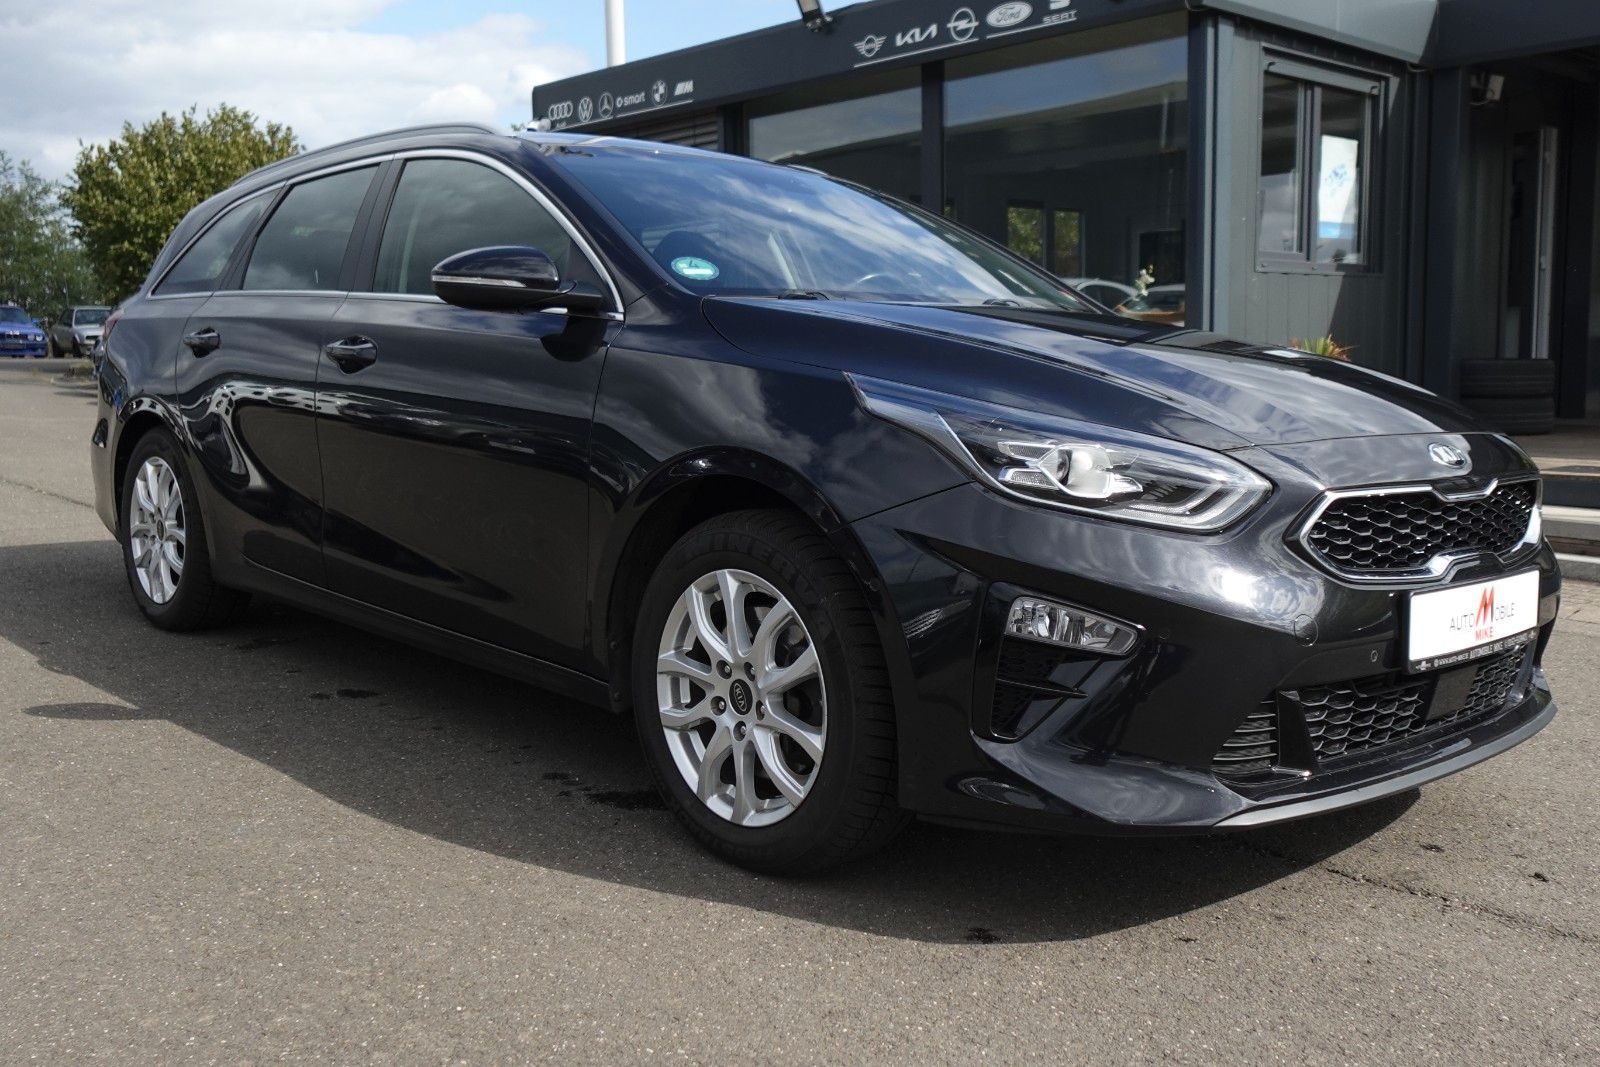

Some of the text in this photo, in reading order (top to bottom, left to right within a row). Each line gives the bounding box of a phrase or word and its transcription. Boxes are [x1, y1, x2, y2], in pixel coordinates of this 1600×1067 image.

[1042, 9, 1078, 24] SEAT
[623, 91, 646, 107] smart
[1474, 626, 1495, 641] MIKE
[735, 687, 745, 707] KIA
